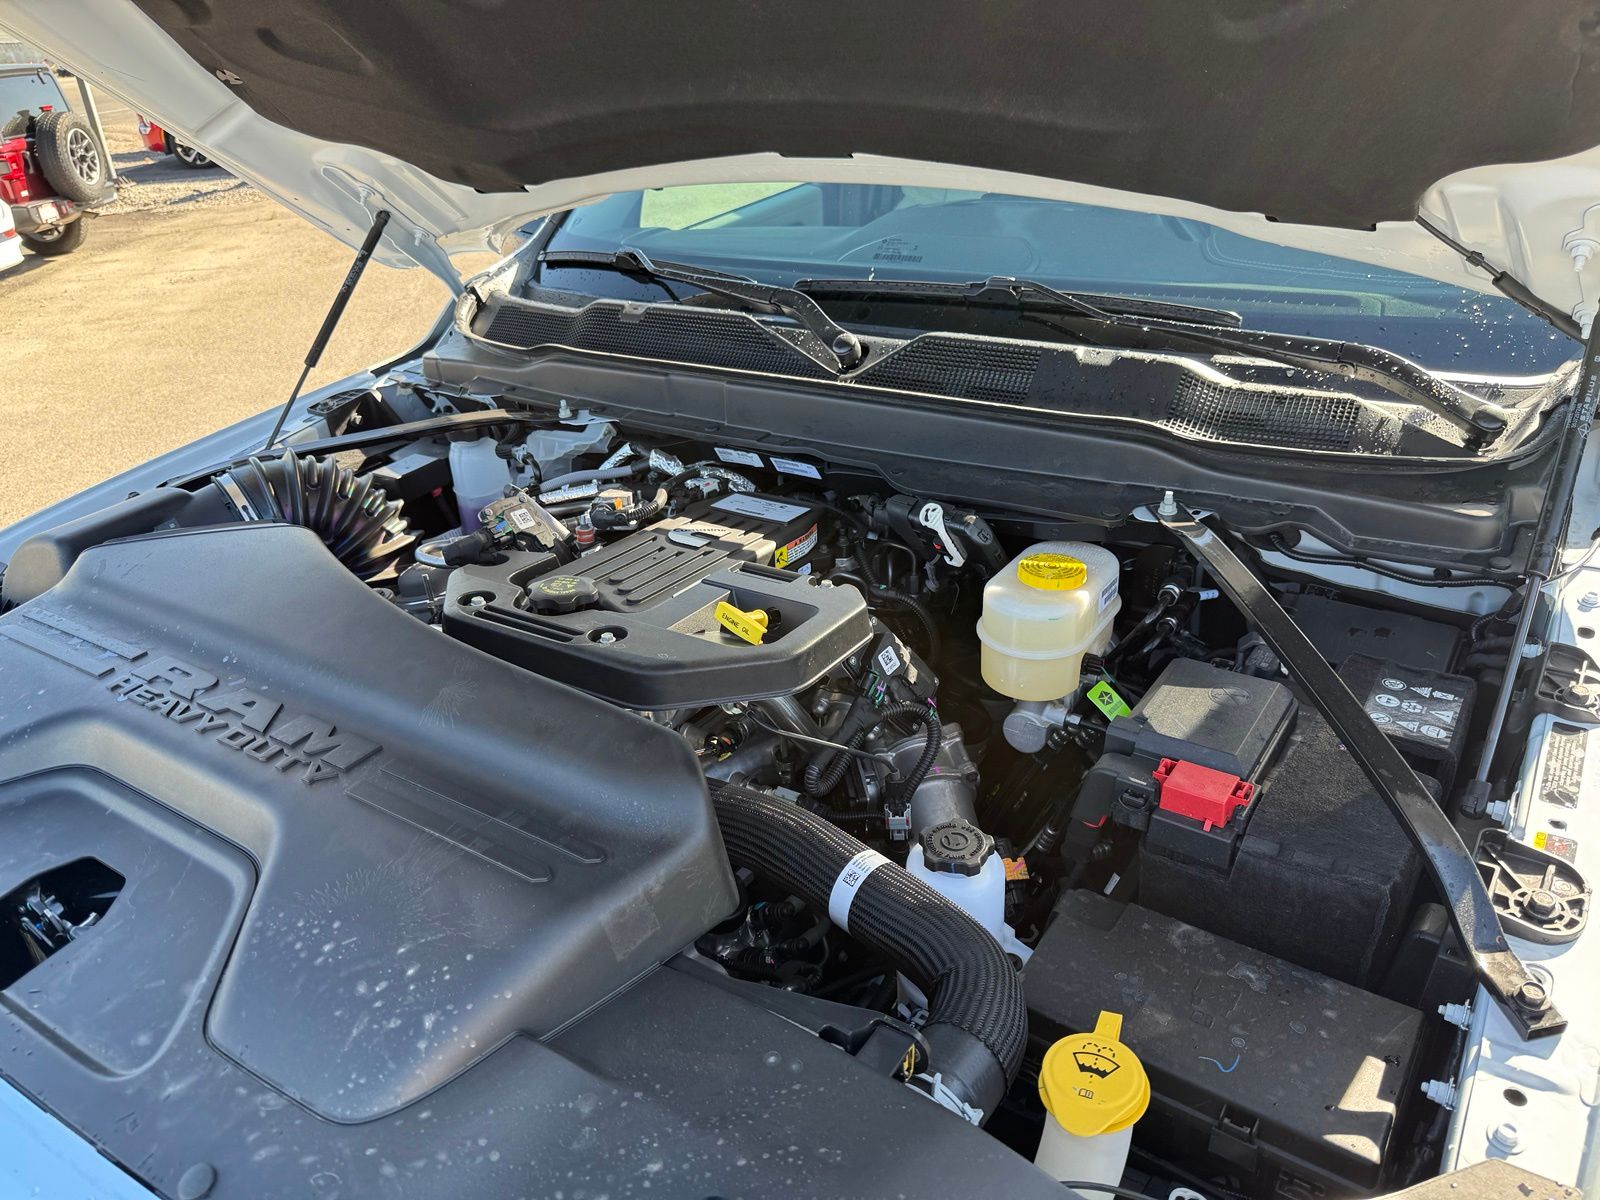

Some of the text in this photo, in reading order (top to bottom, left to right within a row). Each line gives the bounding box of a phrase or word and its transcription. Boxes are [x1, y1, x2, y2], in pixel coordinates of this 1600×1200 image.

[1580, 375, 1597, 420] STABILUS
[722, 613, 750, 636] ENGINE OIL
[106, 677, 339, 785] HEAVY DUTY
[131, 656, 384, 772] RAM
